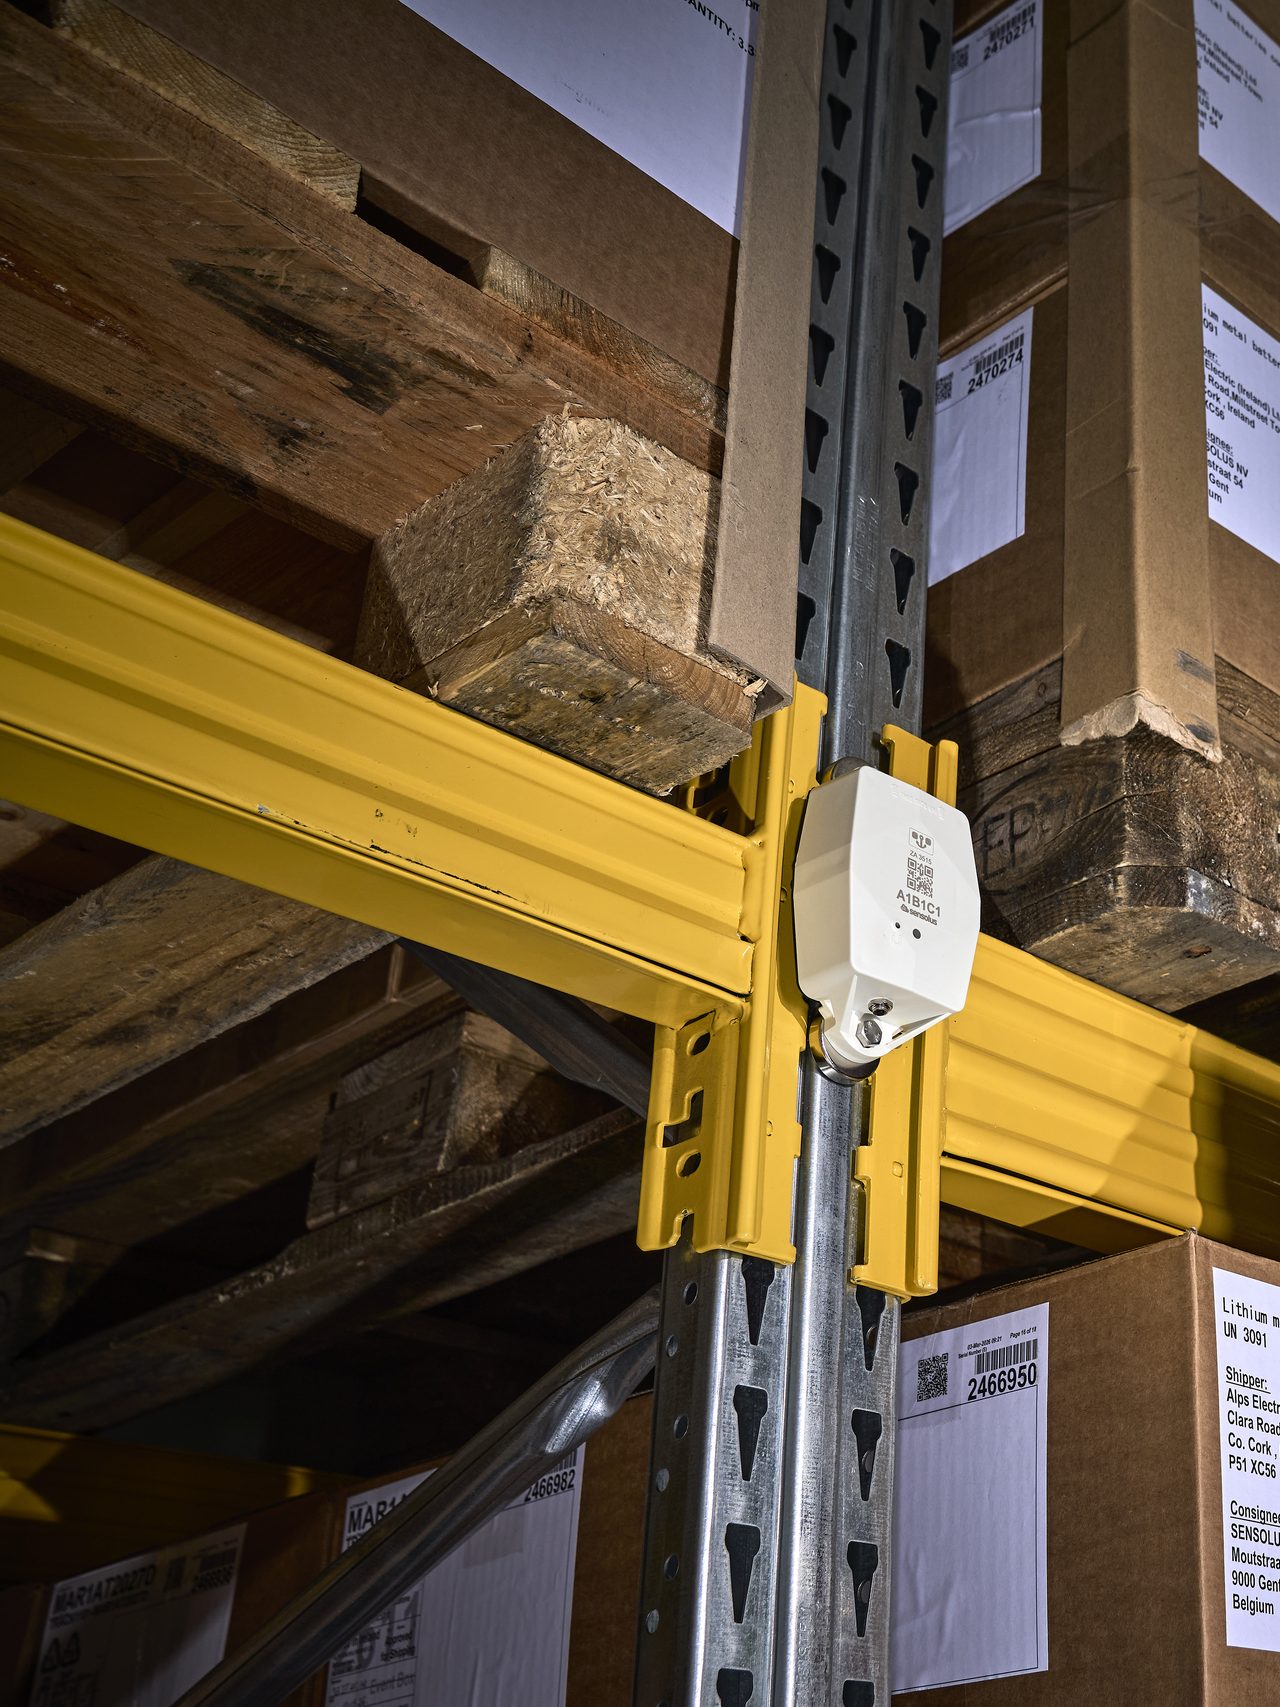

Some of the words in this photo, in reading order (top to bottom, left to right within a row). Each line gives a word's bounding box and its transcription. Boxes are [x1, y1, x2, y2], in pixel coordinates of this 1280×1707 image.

[683, 0, 735, 41] ANTITY:
[983, 15, 1034, 61] 2470271
[1203, 317, 1219, 336] 091
[1222, 320, 1247, 344] metal
[967, 347, 1024, 396] 2470274
[1205, 359, 1236, 388] Electric
[1237, 383, 1271, 416] (Ireland)
[1228, 402, 1256, 429] Ireland
[1207, 429, 1233, 455] ignee:
[1206, 441, 1235, 469] SOLUS
[1236, 463, 1249, 478] NV
[1207, 459, 1232, 482] straat
[1233, 475, 1244, 489] 54
[1208, 473, 1230, 494] Gent
[896, 889, 941, 917] A1B1C1
[909, 908, 938, 926] sensolus
[1223, 1297, 1268, 1325] Lithium
[1223, 1321, 1238, 1340] UN
[1243, 1327, 1267, 1348] 3091
[967, 1362, 1037, 1402] 2466950
[1225, 1366, 1269, 1391] Shipper:
[1226, 1388, 1250, 1408] Alps
[1227, 1410, 1254, 1430] Clara
[1228, 1432, 1245, 1450] Co.
[1248, 1437, 1272, 1456] Cork
[1228, 1454, 1247, 1472] P51
[1250, 1459, 1277, 1479] XC56
[525, 1469, 576, 1503] 2466982
[347, 1494, 406, 1533] MAR1
[1231, 1570, 1256, 1588] 9000
[1232, 1593, 1275, 1616] Belgium
